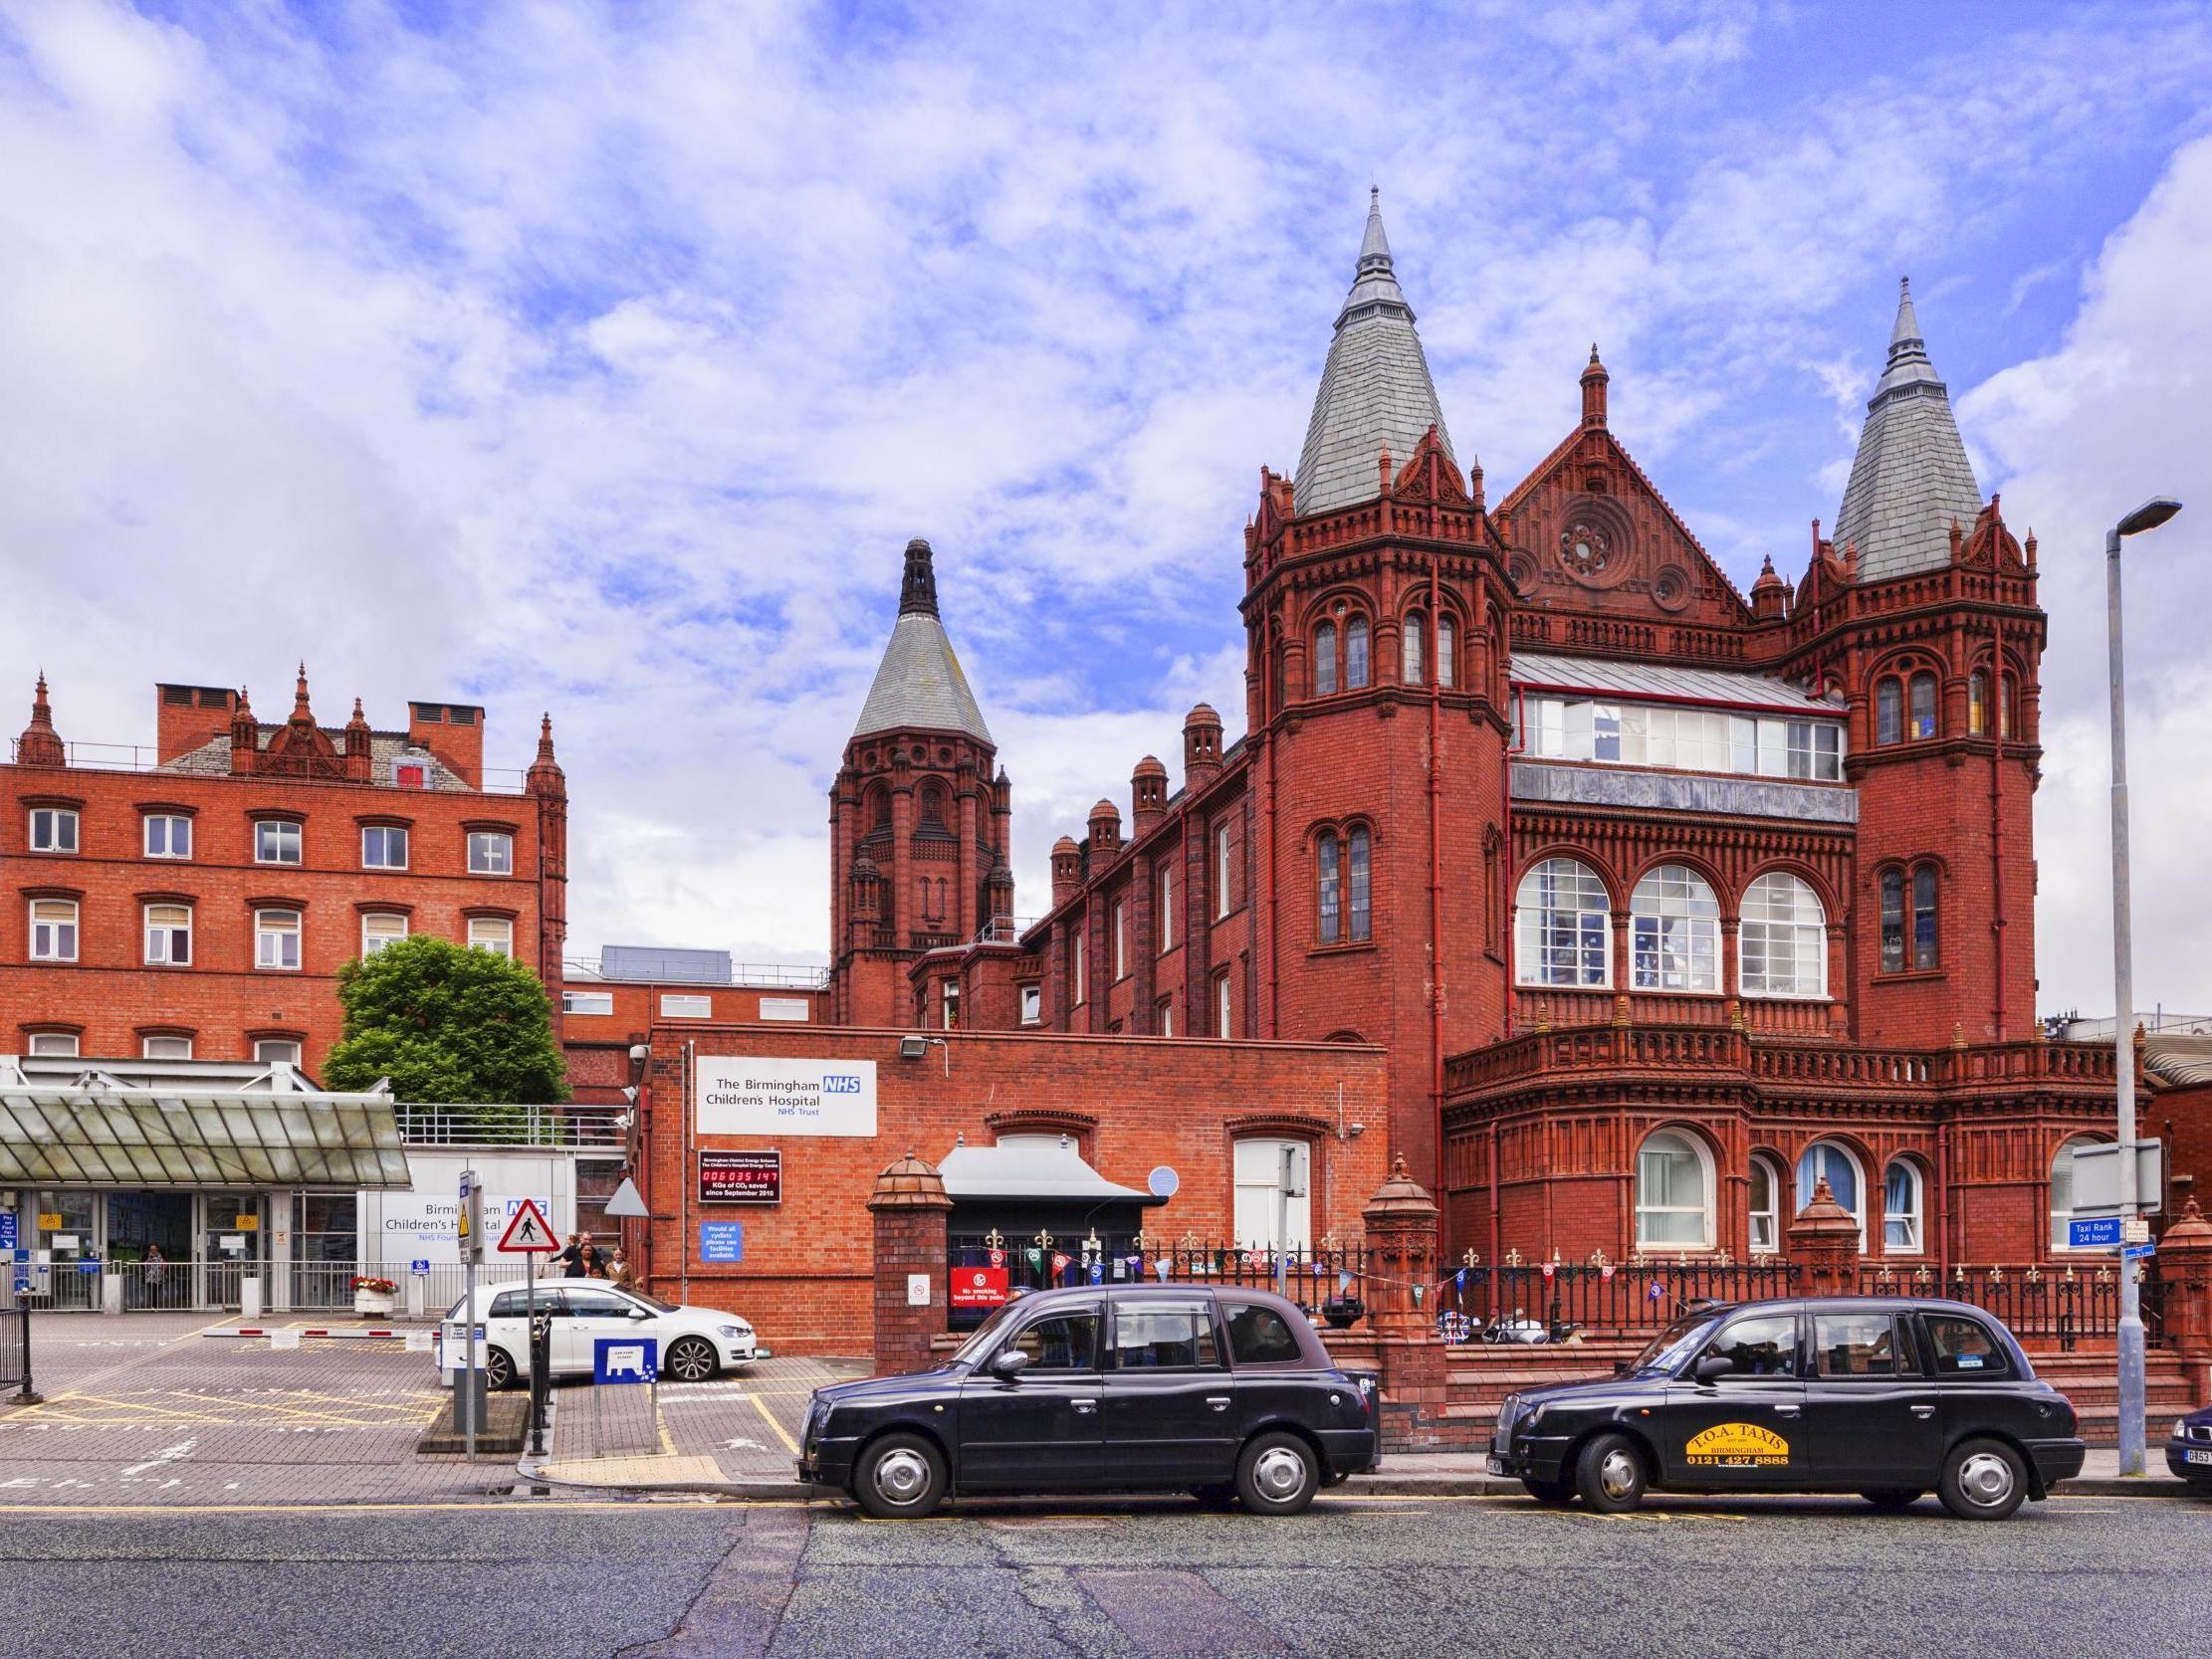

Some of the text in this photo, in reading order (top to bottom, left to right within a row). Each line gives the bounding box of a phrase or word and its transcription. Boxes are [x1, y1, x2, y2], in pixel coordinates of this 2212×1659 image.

[717, 1079, 820, 1093] The Birmingham
[823, 1077, 860, 1093] NHS
[769, 1095, 820, 1108] Hospital
[426, 1201, 547, 1215] Birmiam NS
[385, 1219, 501, 1230] Children's Htal
[2076, 1224, 2091, 1233] Taxi
[1692, 1425, 1783, 1449] T.O.A. TAXIS
[1687, 1456, 1789, 1465] 0121 427 8888
